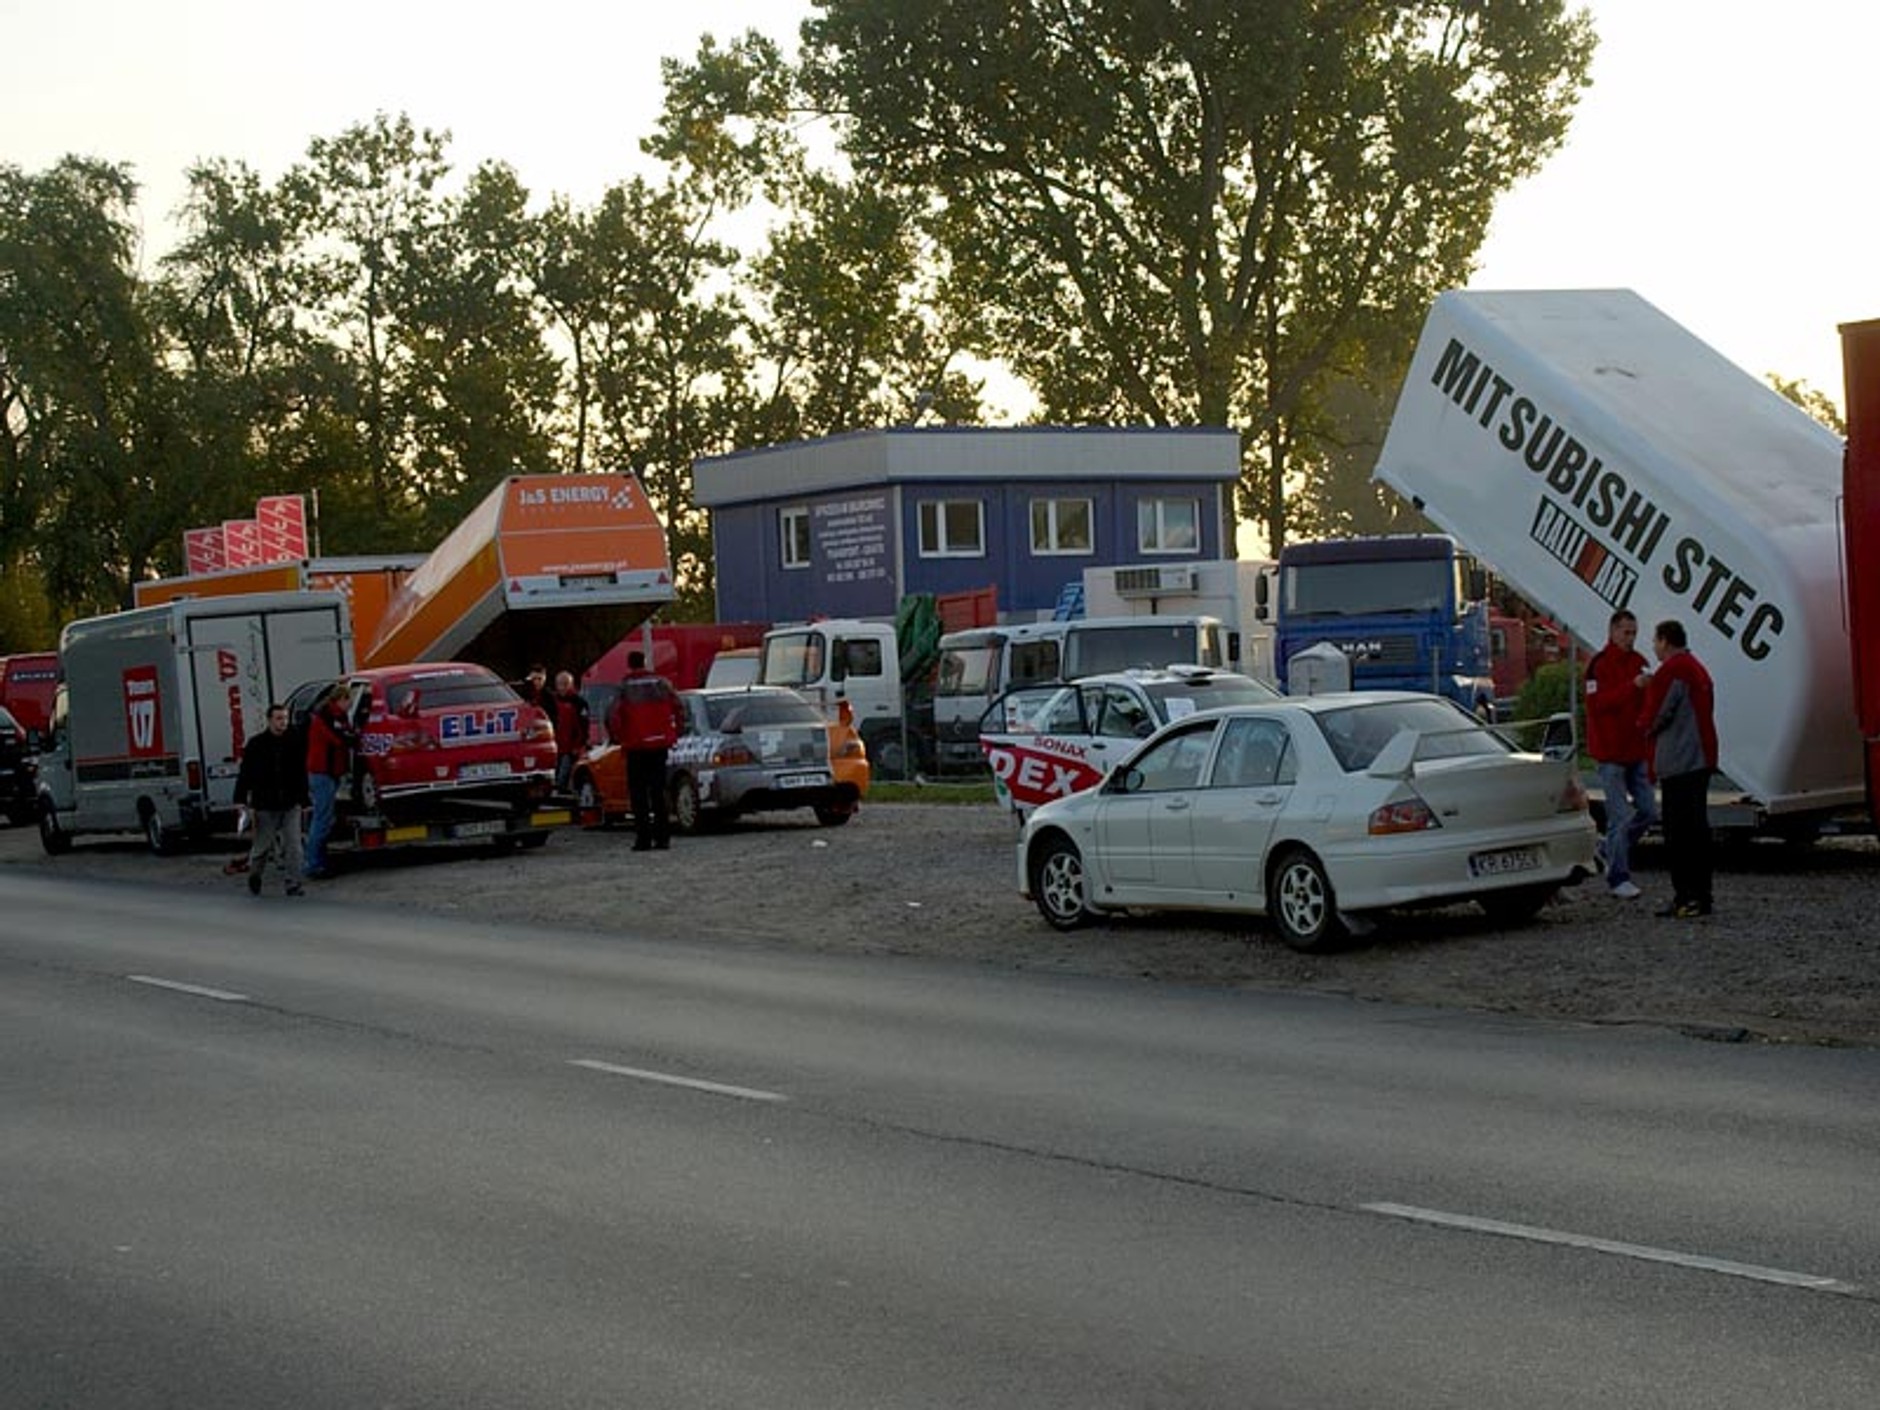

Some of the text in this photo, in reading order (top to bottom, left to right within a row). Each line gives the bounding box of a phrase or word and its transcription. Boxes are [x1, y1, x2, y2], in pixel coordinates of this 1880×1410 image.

[551, 486, 610, 503] ENERGY
[1431, 338, 1785, 661] MITSUBISHI STEC
[1342, 642, 1382, 652] MAN
[1034, 735, 1088, 758] SONAX
